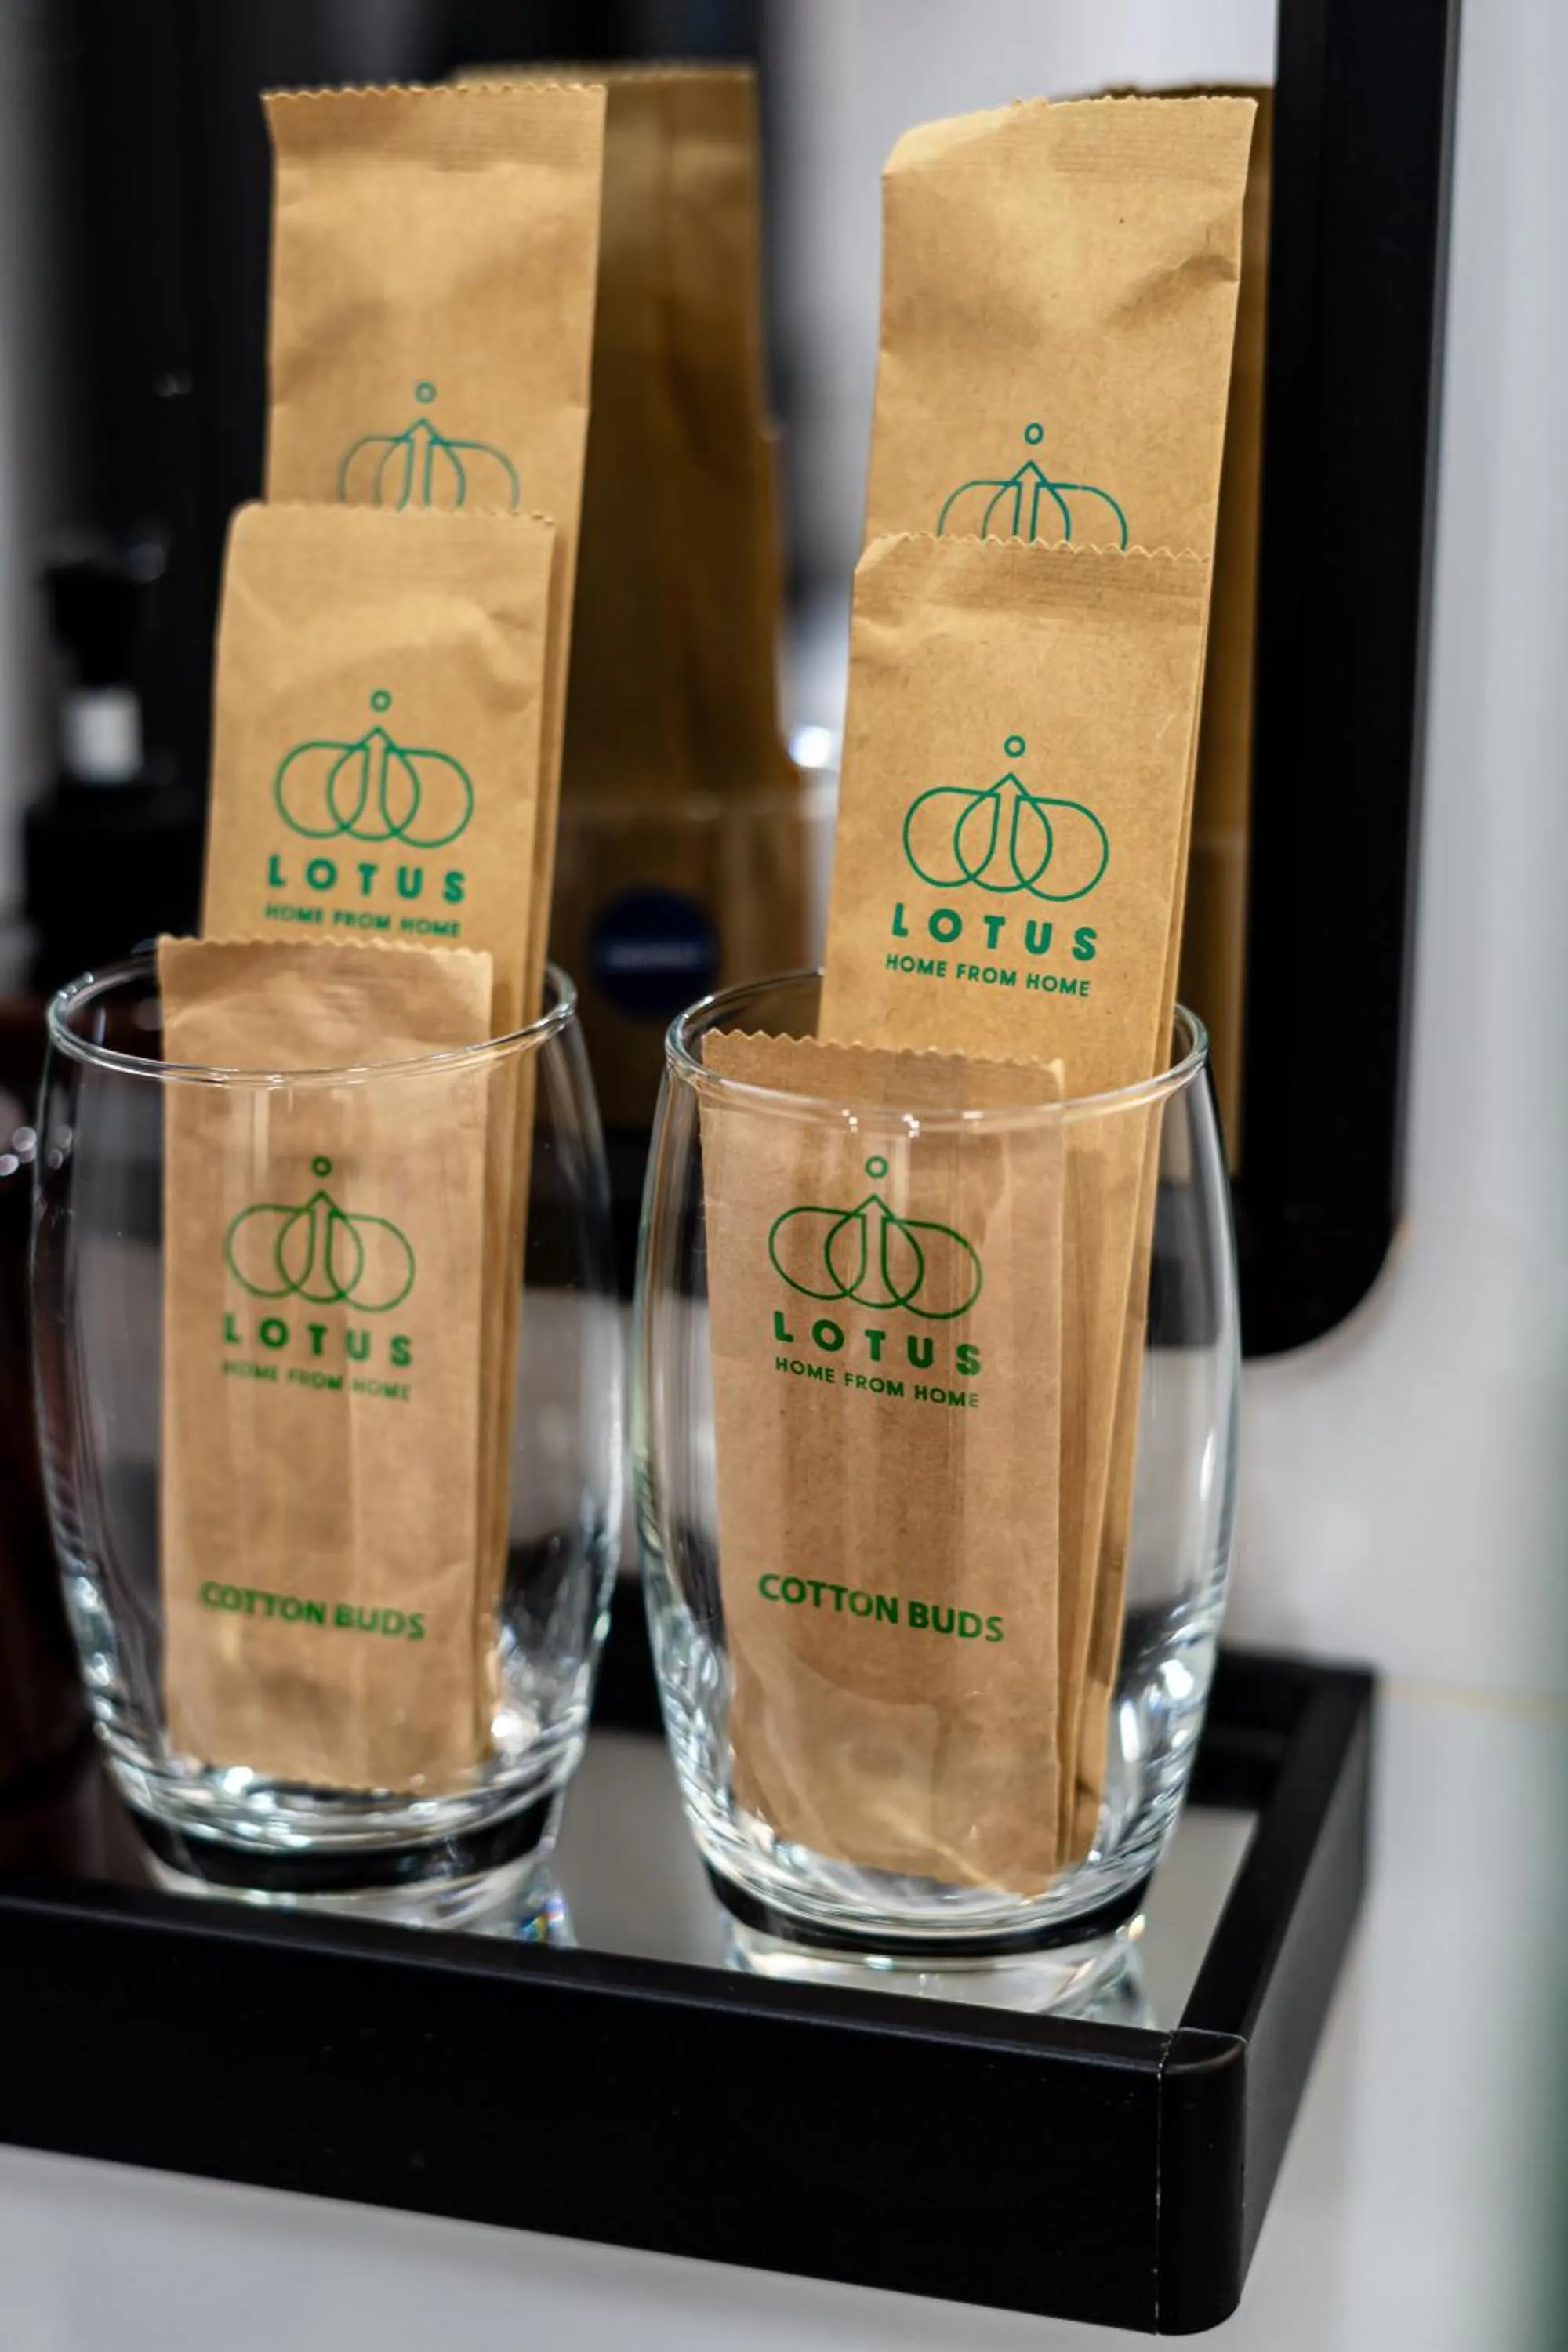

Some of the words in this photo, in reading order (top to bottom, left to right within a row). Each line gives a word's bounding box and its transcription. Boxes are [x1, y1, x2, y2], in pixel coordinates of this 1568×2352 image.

[267, 853, 466, 904] LOTUS
[265, 902, 323, 926] HOME
[332, 909, 390, 931] FROM
[400, 916, 461, 938] HOME
[891, 903, 1097, 961] LOTUS
[885, 954, 946, 978] HOME
[956, 964, 1017, 986] FROM
[1026, 973, 1091, 997] HOME
[223, 1312, 413, 1367] LOTUS
[773, 1311, 981, 1376] LOTUS
[222, 1358, 279, 1381] HOME
[288, 1369, 343, 1392] FROM
[351, 1378, 411, 1402] HOME
[775, 1356, 835, 1384] HOME
[844, 1372, 905, 1397] FROM
[914, 1385, 979, 1408] HOME
[200, 1580, 325, 1627] COTTON
[333, 1603, 426, 1642] BUDS
[758, 1573, 898, 1624] COTTON
[909, 1600, 1004, 1642] BUDS
